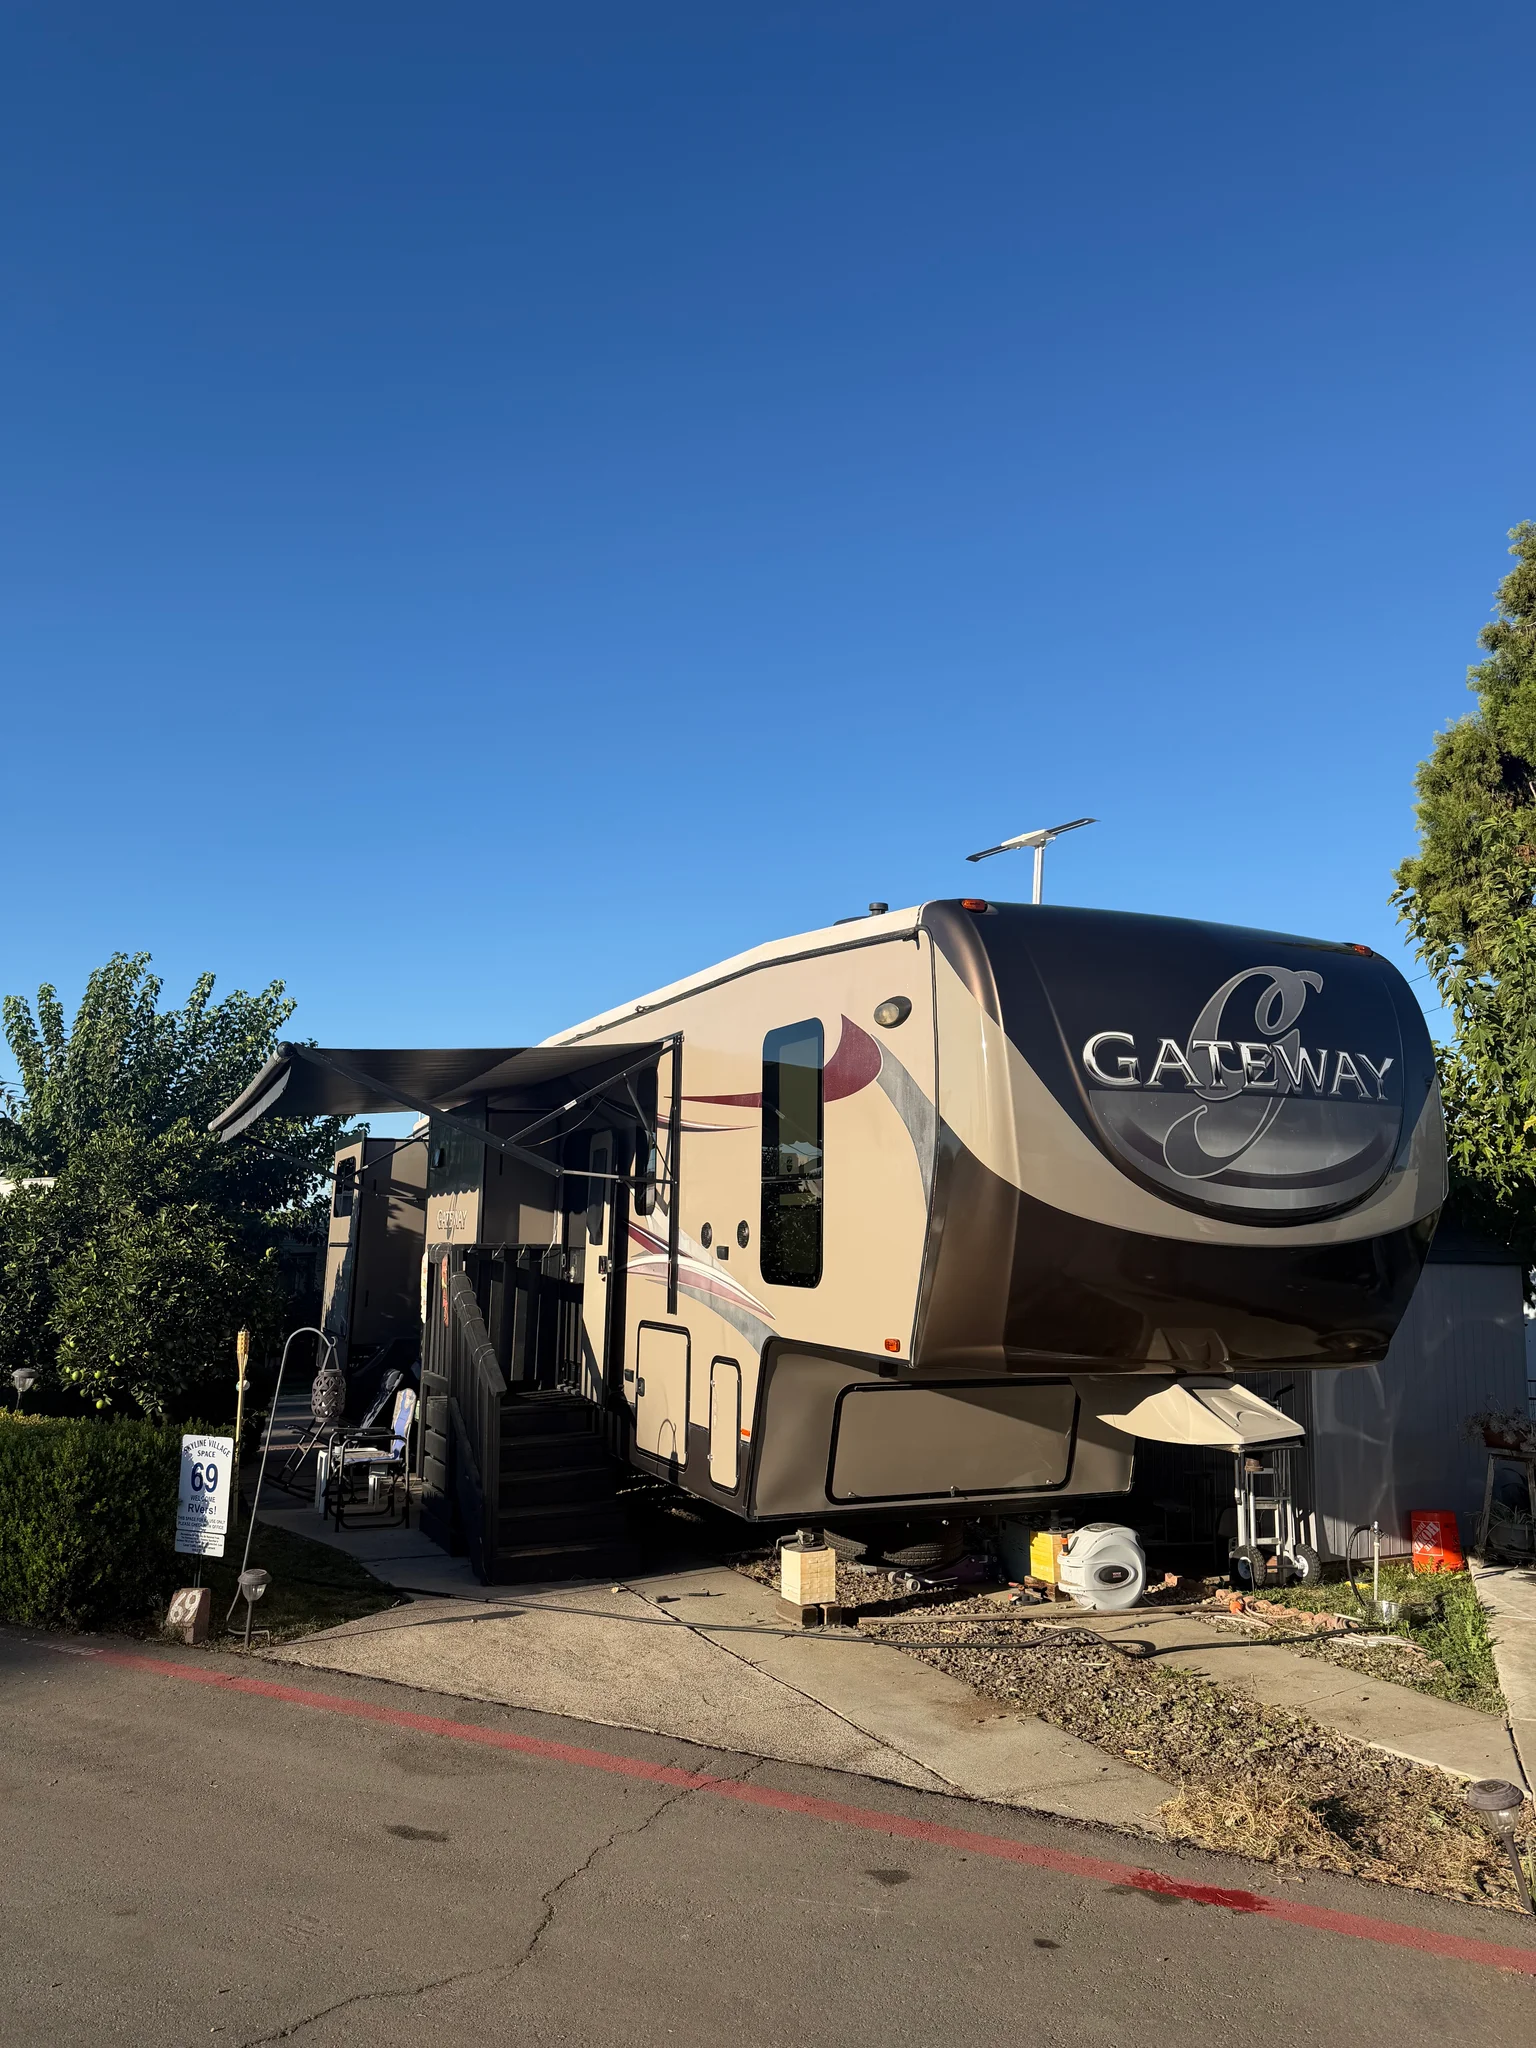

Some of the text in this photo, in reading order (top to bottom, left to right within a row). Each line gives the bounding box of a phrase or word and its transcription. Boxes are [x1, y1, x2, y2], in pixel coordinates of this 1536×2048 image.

[1082, 1031, 1395, 1101] GATEWAY
[183, 1439, 231, 1458] SKYLINE VILLAGE
[197, 1449, 216, 1458] SPACE
[190, 1462, 219, 1493] 69
[190, 1494, 216, 1503] WELCOME
[187, 1503, 217, 1515] RVers!
[170, 1589, 203, 1624] 69
